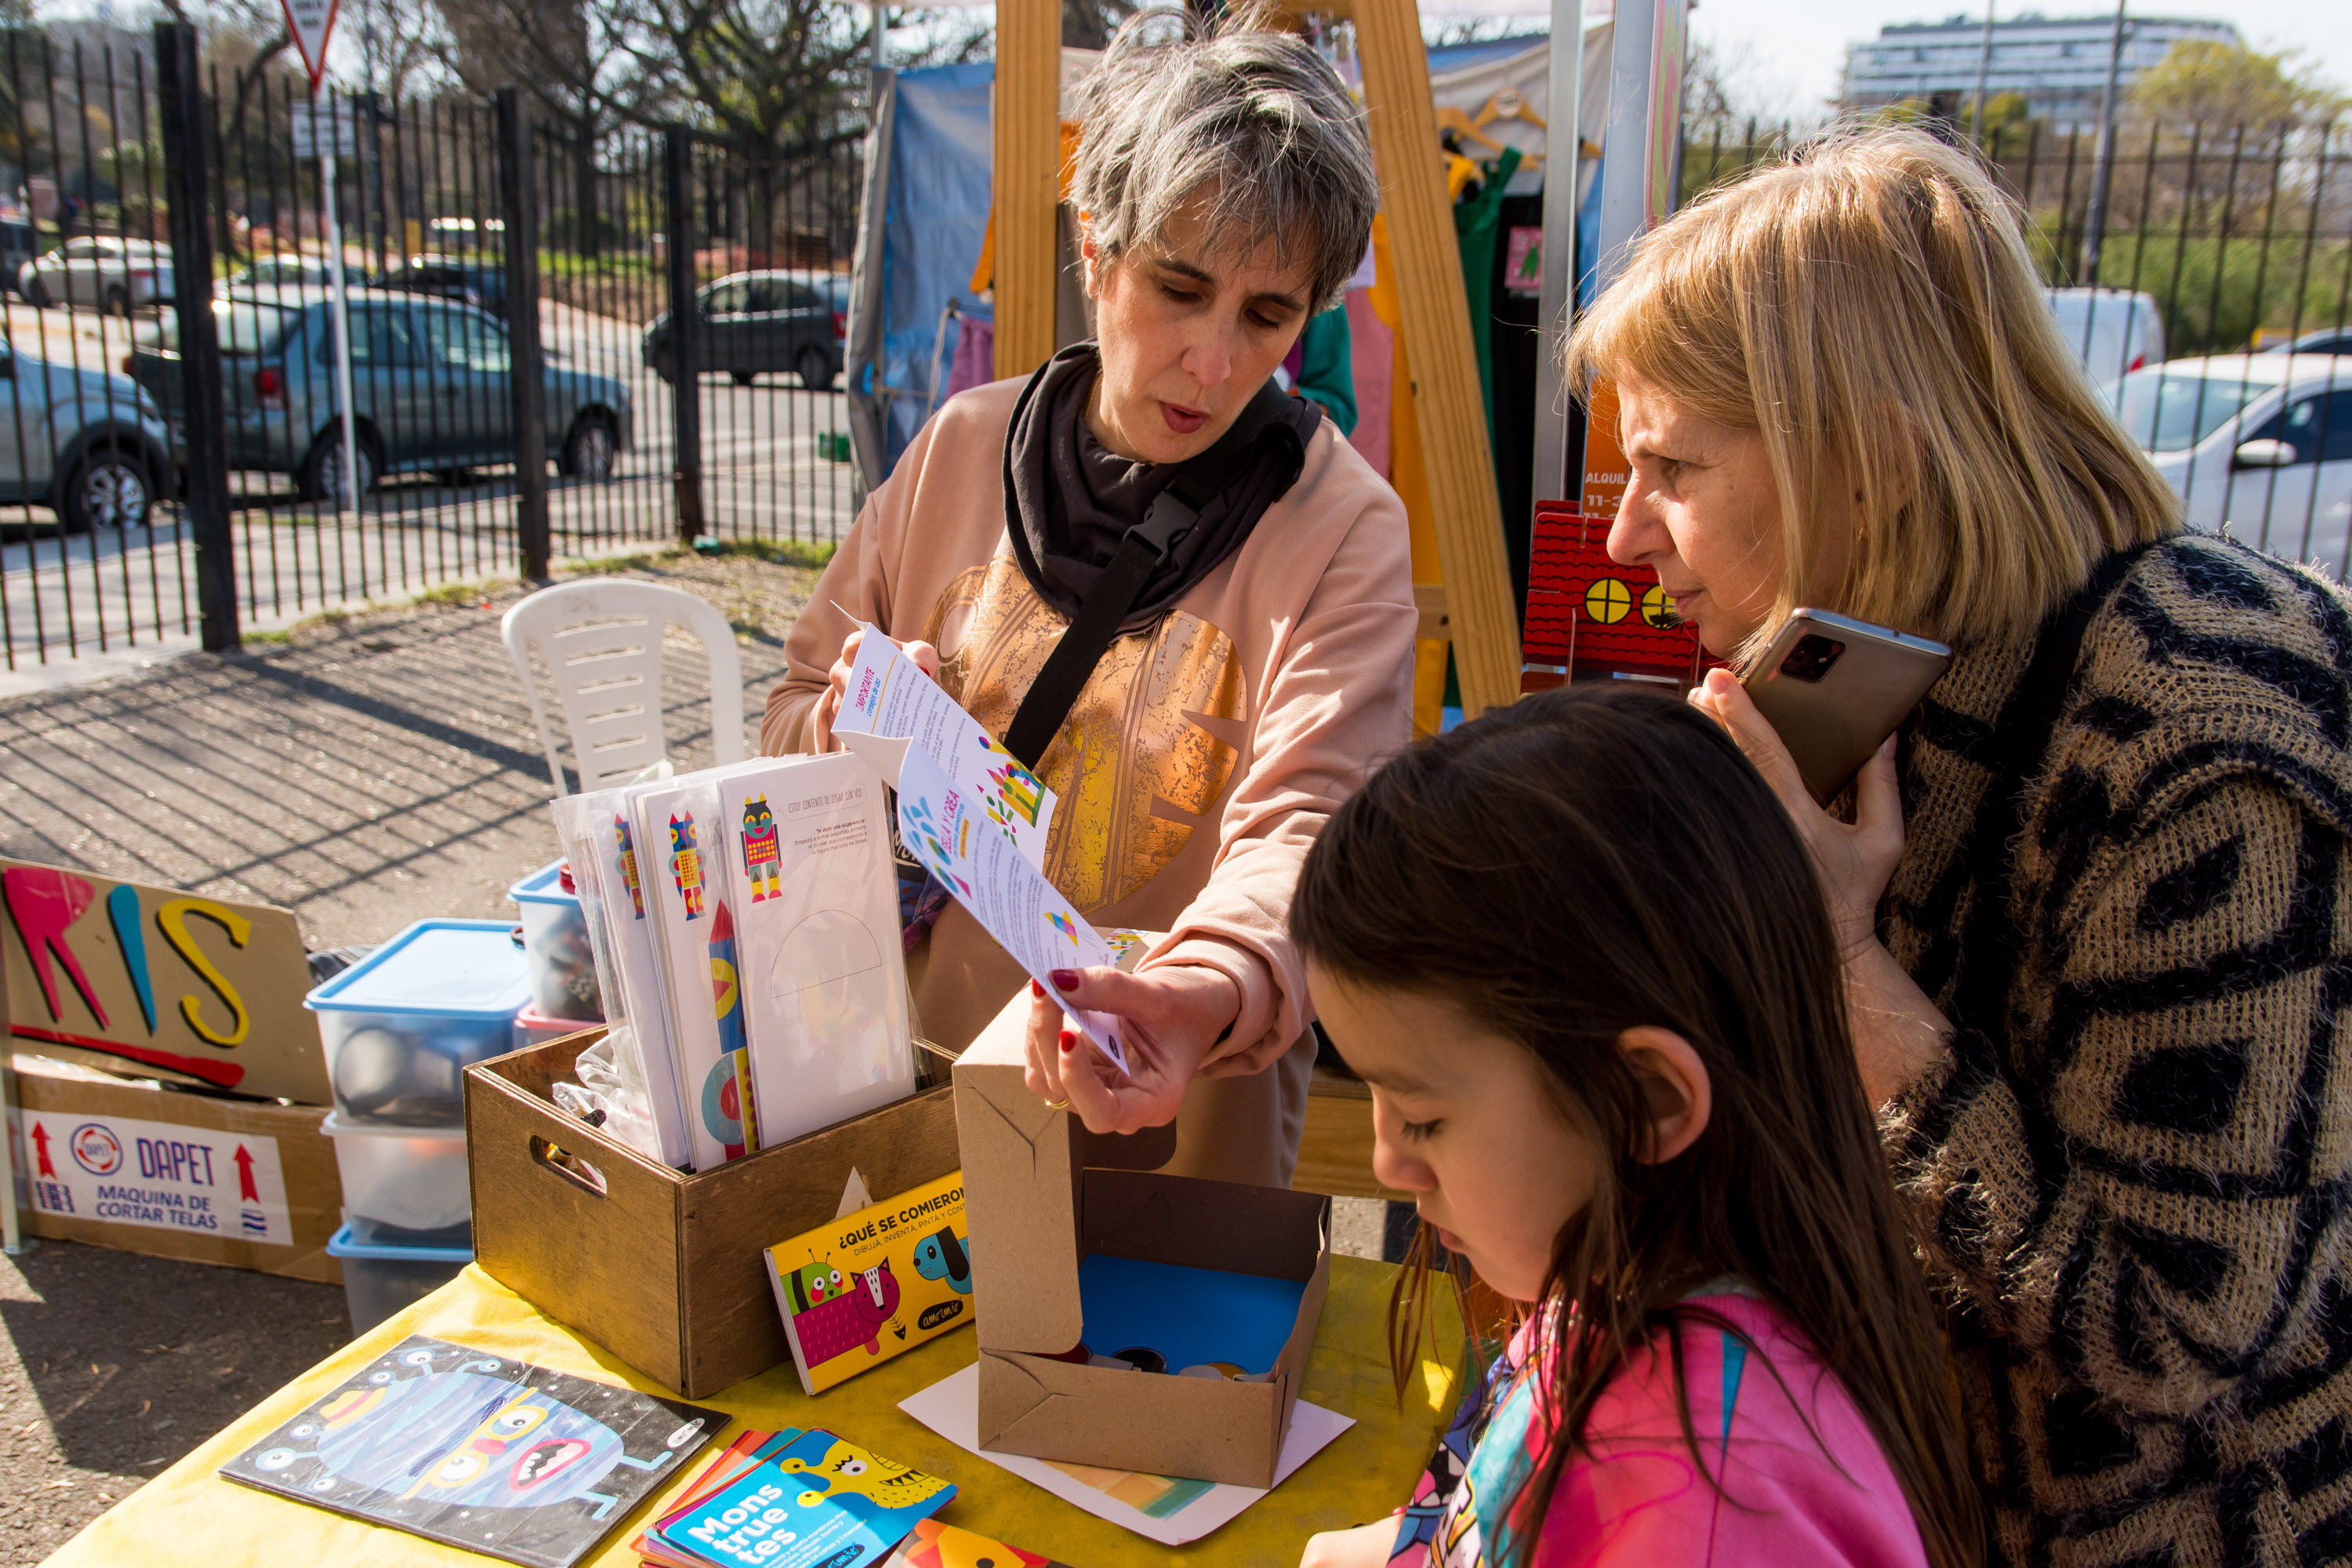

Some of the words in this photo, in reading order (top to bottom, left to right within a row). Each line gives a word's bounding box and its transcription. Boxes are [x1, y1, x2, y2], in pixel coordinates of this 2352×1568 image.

[855, 666, 876, 713] IMPORTANTE
[866, 695, 877, 717] consejos
[872, 687, 879, 697] de
[788, 802, 800, 813] ESTOY
[803, 796, 824, 810] CONTENTO
[824, 795, 829, 805] DE
[831, 792, 844, 804] JUGAR
[854, 788, 862, 798] VOS
[943, 789, 960, 819] CREA
[841, 818, 866, 828] sugerencia:
[942, 815, 949, 828] Y
[136, 1138, 215, 1187] DAPET
[96, 1185, 185, 1208] MAQUINA
[188, 1196, 211, 1212] DE
[96, 1202, 164, 1223] CORTAR
[169, 1208, 218, 1230] TELAS
[839, 1221, 877, 1250] ¿QUÉ
[878, 1215, 898, 1232] SE
[853, 1238, 884, 1256] DIBUJÁ,
[884, 1225, 918, 1243] INVENTÁ,
[919, 1214, 940, 1229] PINTÁ
[687, 1483, 782, 1544] Mons
[711, 1508, 789, 1553] true
[735, 1528, 797, 1565] tes
